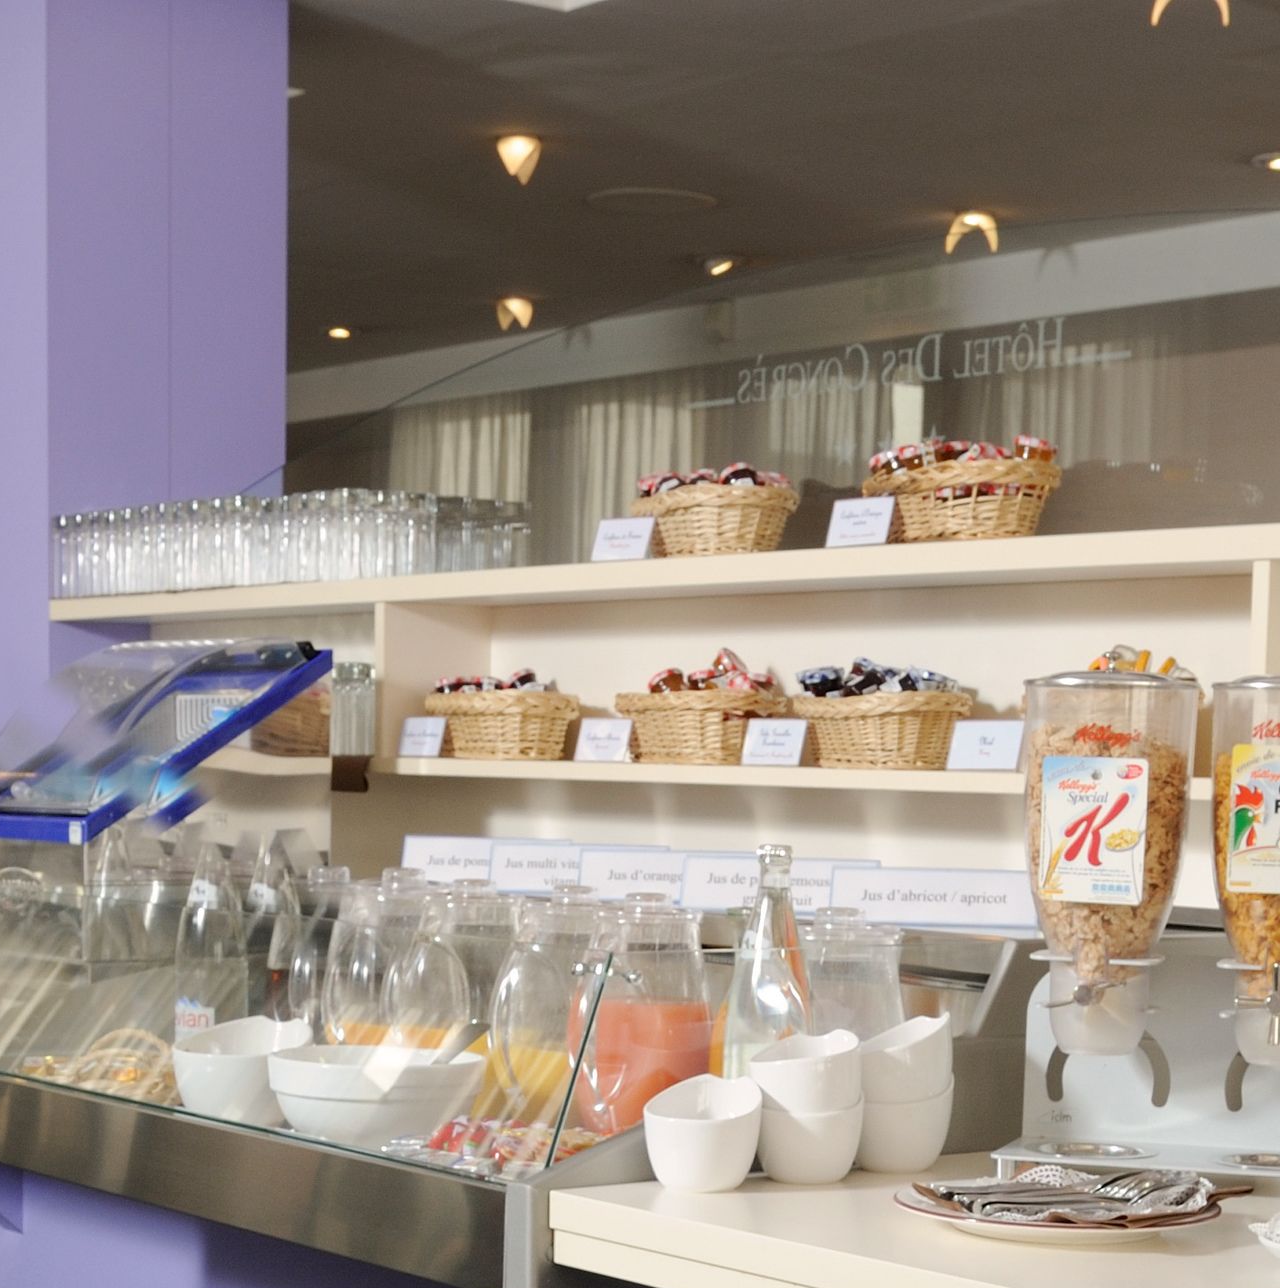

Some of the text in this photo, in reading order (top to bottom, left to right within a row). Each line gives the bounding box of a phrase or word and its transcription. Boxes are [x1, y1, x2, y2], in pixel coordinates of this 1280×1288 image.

[1067, 791, 1108, 806] Special
[1064, 793, 1129, 866] K
[427, 855, 445, 866] Jus
[448, 855, 461, 866] de
[505, 857, 523, 869] Jus
[526, 858, 557, 869] multi
[607, 869, 628, 881] Jus
[706, 872, 727, 885] Jus
[730, 872, 747, 885] de
[861, 889, 883, 901] Jus
[887, 889, 947, 902] d'abricot
[959, 891, 1007, 905] apricot
